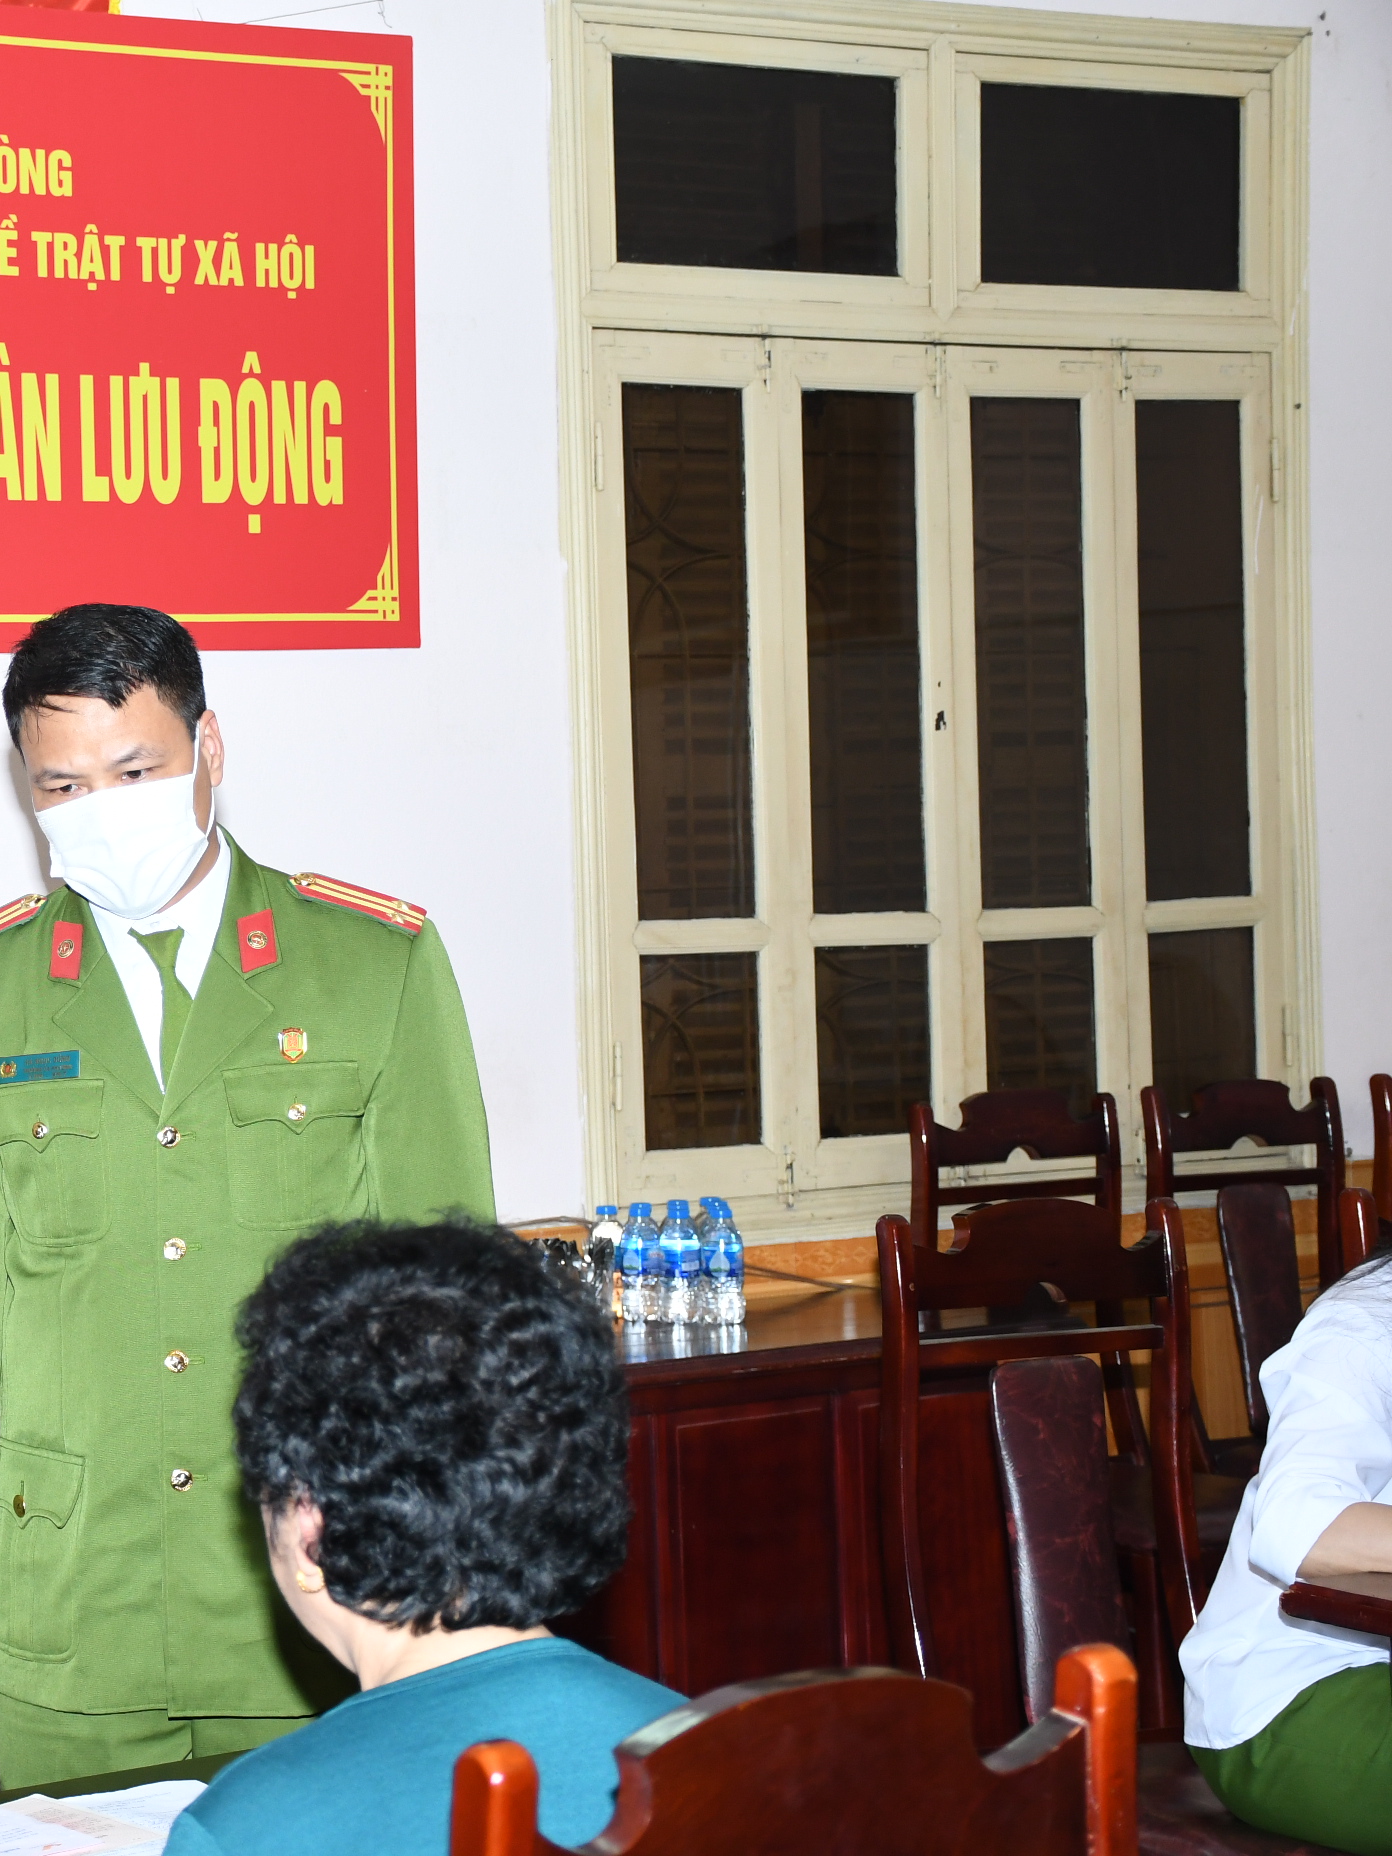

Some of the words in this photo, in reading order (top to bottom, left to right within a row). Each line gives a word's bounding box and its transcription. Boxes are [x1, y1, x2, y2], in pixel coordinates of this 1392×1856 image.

[32, 225, 125, 290] TRẬT
[137, 235, 186, 293] TỰ
[195, 233, 244, 286] XÃ
[256, 235, 314, 298] HỘI
[80, 363, 181, 504] LƯU
[199, 352, 343, 533] ĐỘNG
